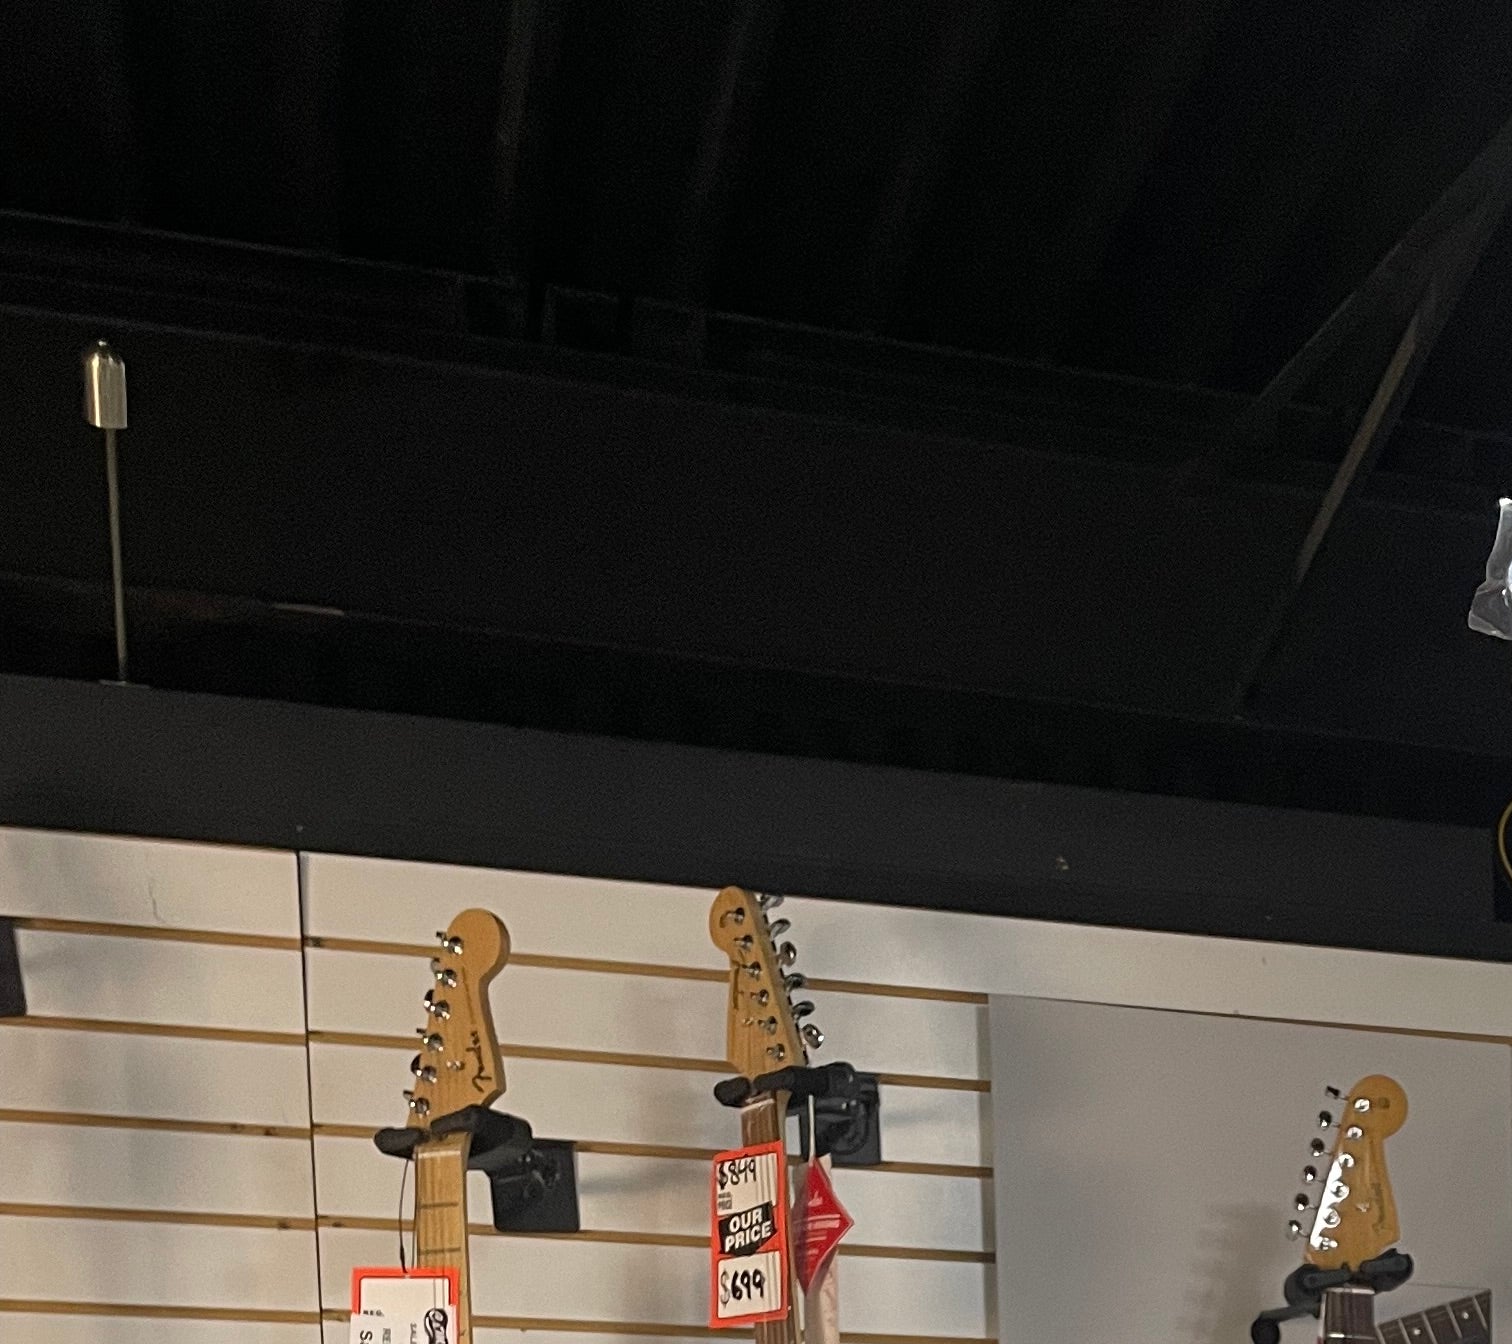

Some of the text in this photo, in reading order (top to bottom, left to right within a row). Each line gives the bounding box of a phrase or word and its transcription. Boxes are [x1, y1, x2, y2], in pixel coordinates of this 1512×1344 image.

[718, 1158, 757, 1190] $849
[724, 1221, 772, 1253] PRICE
[729, 1209, 763, 1233] OUR
[720, 1268, 766, 1308] $699
